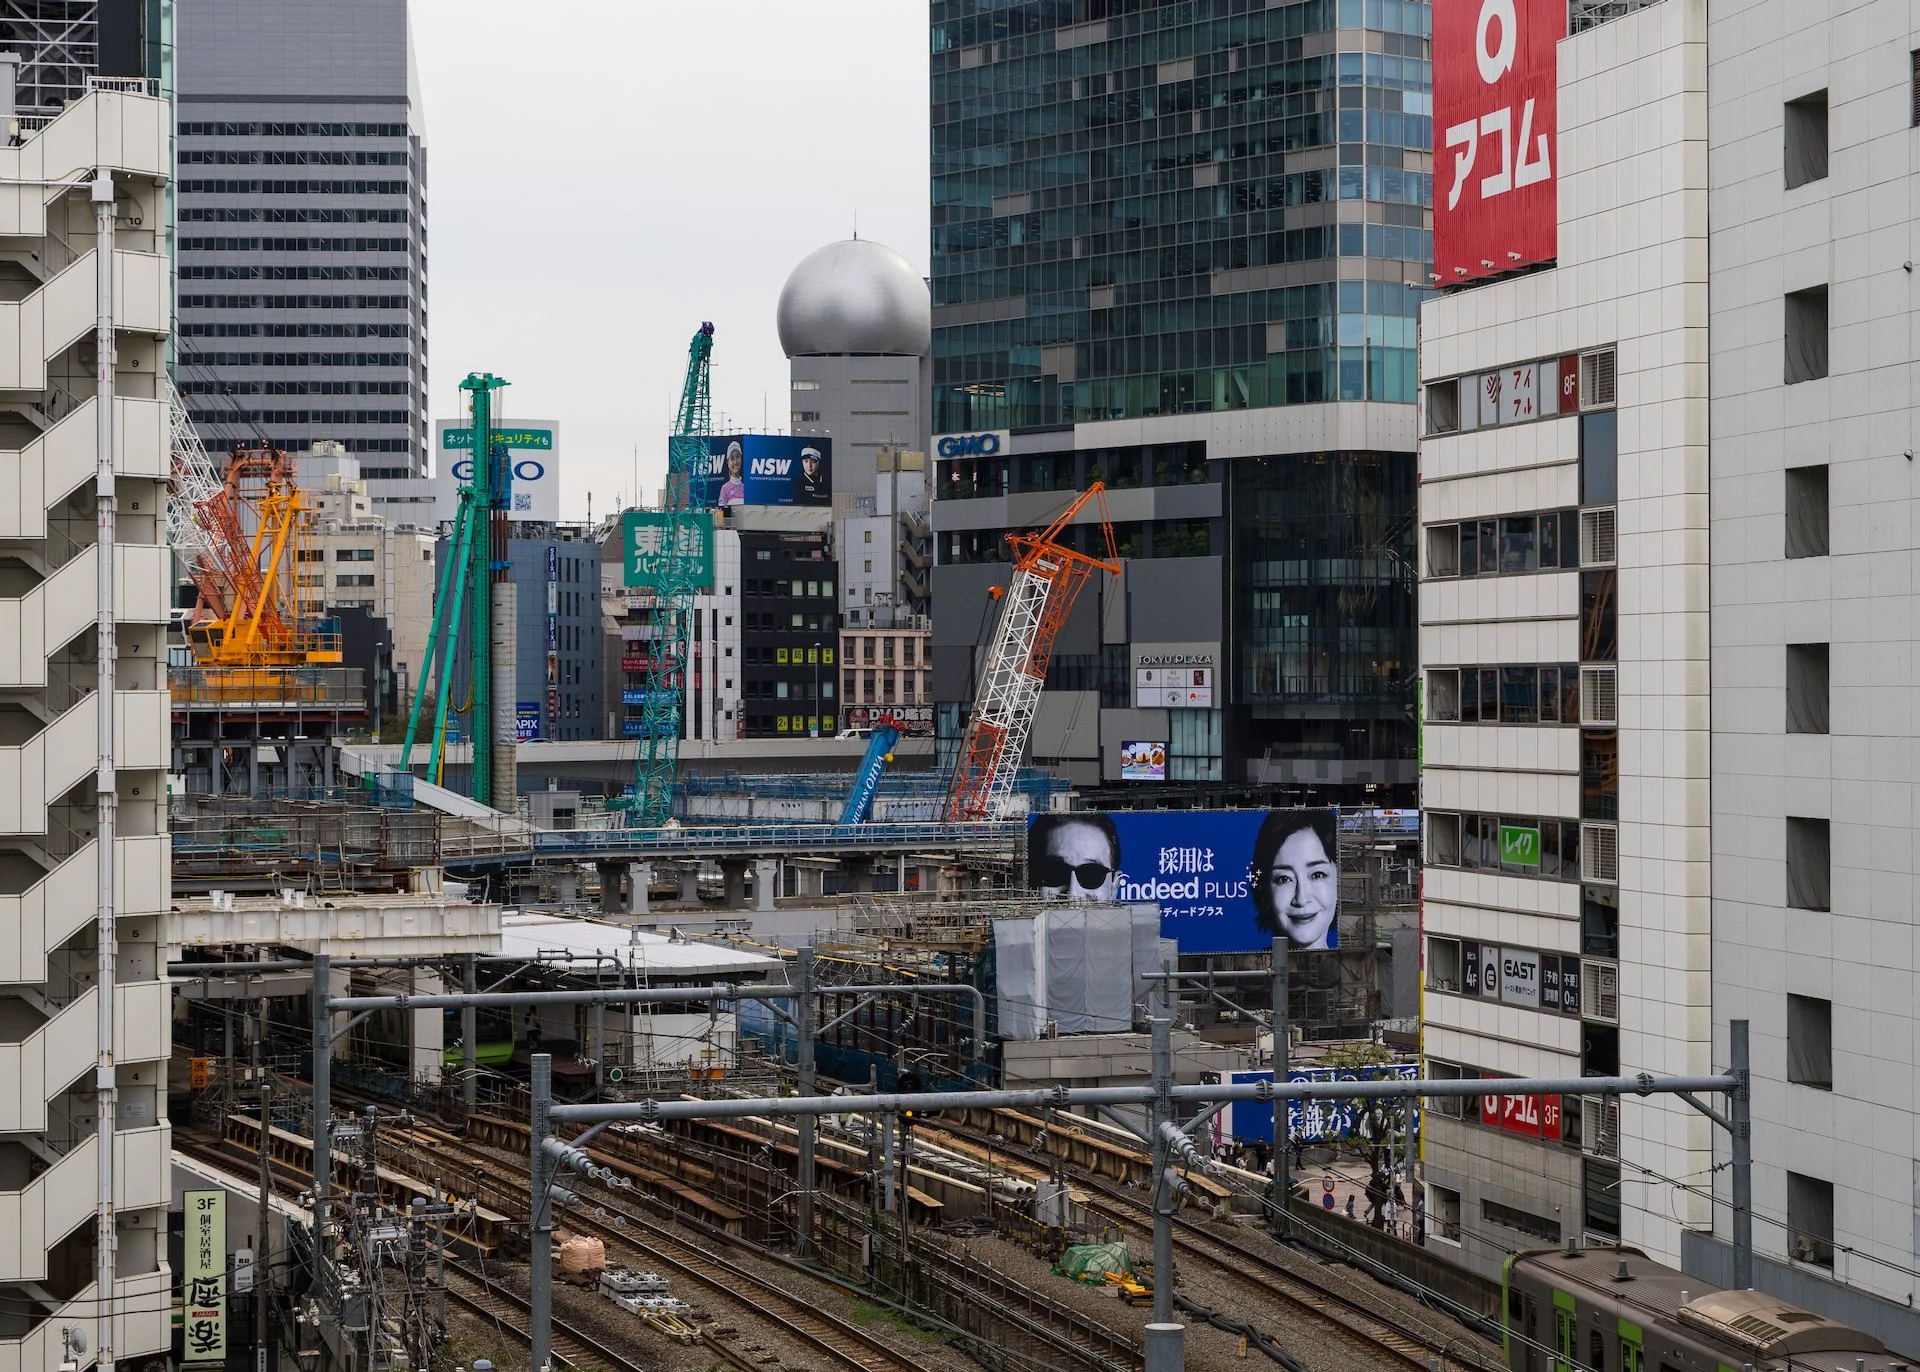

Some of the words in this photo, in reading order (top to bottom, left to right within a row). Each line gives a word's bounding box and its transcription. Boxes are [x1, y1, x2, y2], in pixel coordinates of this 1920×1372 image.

[1446, 97, 1552, 211] アコム
[129, 217, 142, 225] 10
[132, 359, 139, 368] 9
[1563, 373, 1576, 396] 8F
[447, 433, 549, 446] ネットキュリティも
[938, 433, 1000, 458] GMO
[451, 460, 545, 481] GO
[750, 458, 792, 476] NSW
[131, 502, 139, 511] 8
[132, 644, 139, 653] 7
[1138, 655, 1172, 664] TOKYU
[1175, 654, 1212, 664] PLAZA
[516, 719, 538, 729] APIX
[132, 787, 140, 796] 6
[851, 790, 869, 824] HUMAN
[866, 755, 885, 790] OHYA
[1505, 831, 1533, 856] レイク
[1158, 846, 1215, 875] 採用は
[1117, 875, 1199, 900] indeed
[1205, 881, 1248, 899] PLUS
[132, 929, 139, 938] 5
[1466, 964, 1477, 988] 4F
[1504, 959, 1536, 981] EAST
[132, 1072, 139, 1081] 4
[1503, 1094, 1538, 1126] アコム
[1544, 1104, 1559, 1126] 3F
[196, 1197, 216, 1210] 3F
[132, 1215, 140, 1224] 3
[199, 1214, 211, 1270] 個室居酒屋
